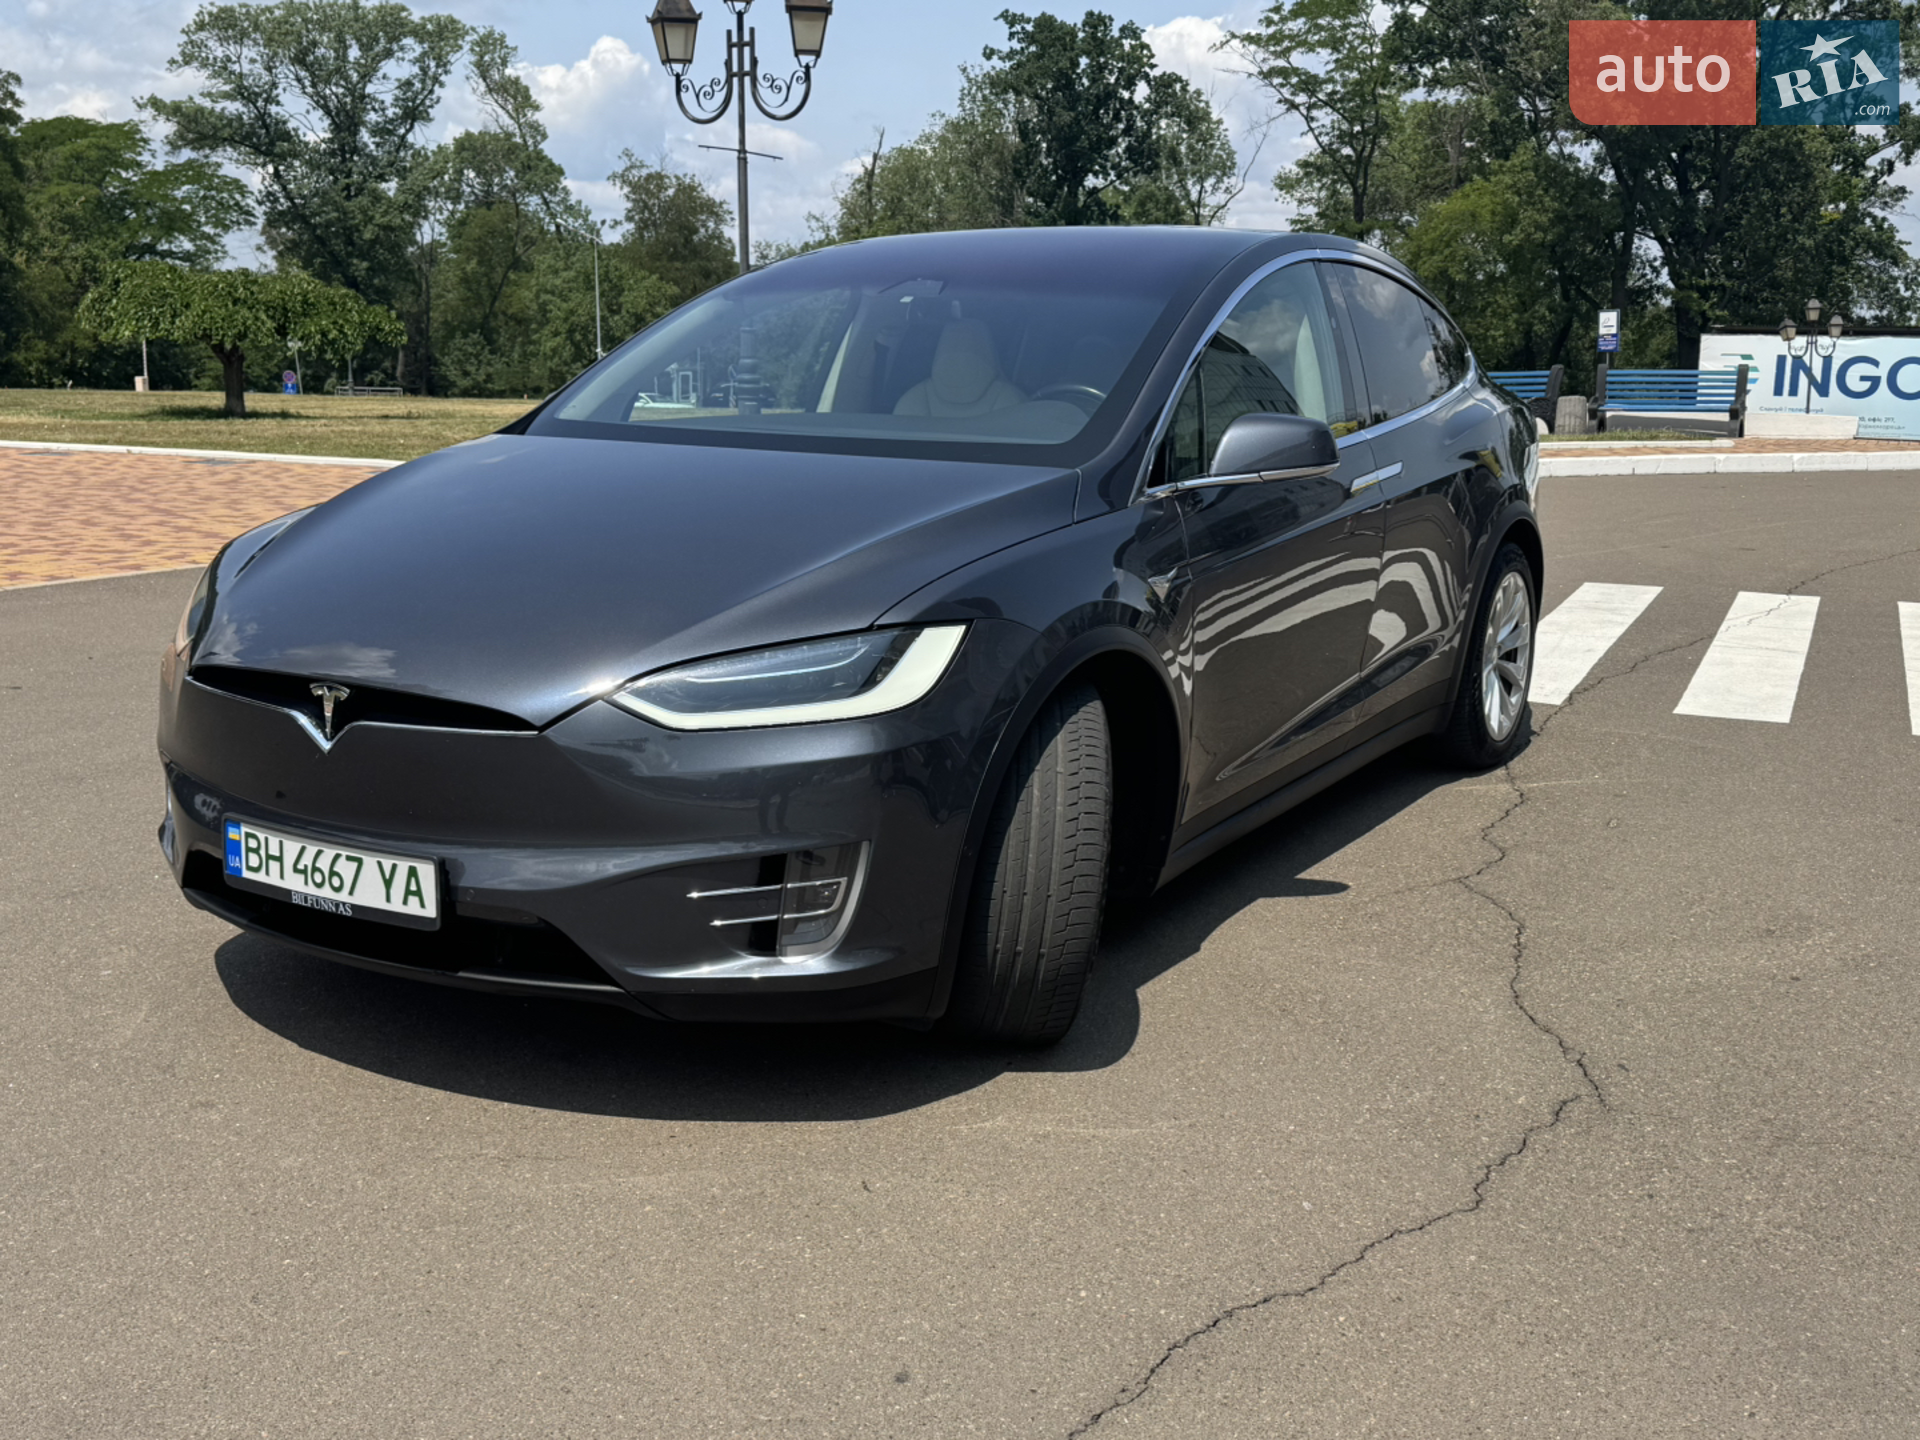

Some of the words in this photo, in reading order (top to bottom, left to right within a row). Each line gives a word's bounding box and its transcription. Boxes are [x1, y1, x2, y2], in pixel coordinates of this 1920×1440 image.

[228, 854, 241, 869] UA
[244, 831, 285, 880] BH
[292, 845, 364, 897] 4667
[376, 860, 427, 909] YA
[291, 891, 340, 913] BILFUNN
[337, 902, 353, 917] AS
